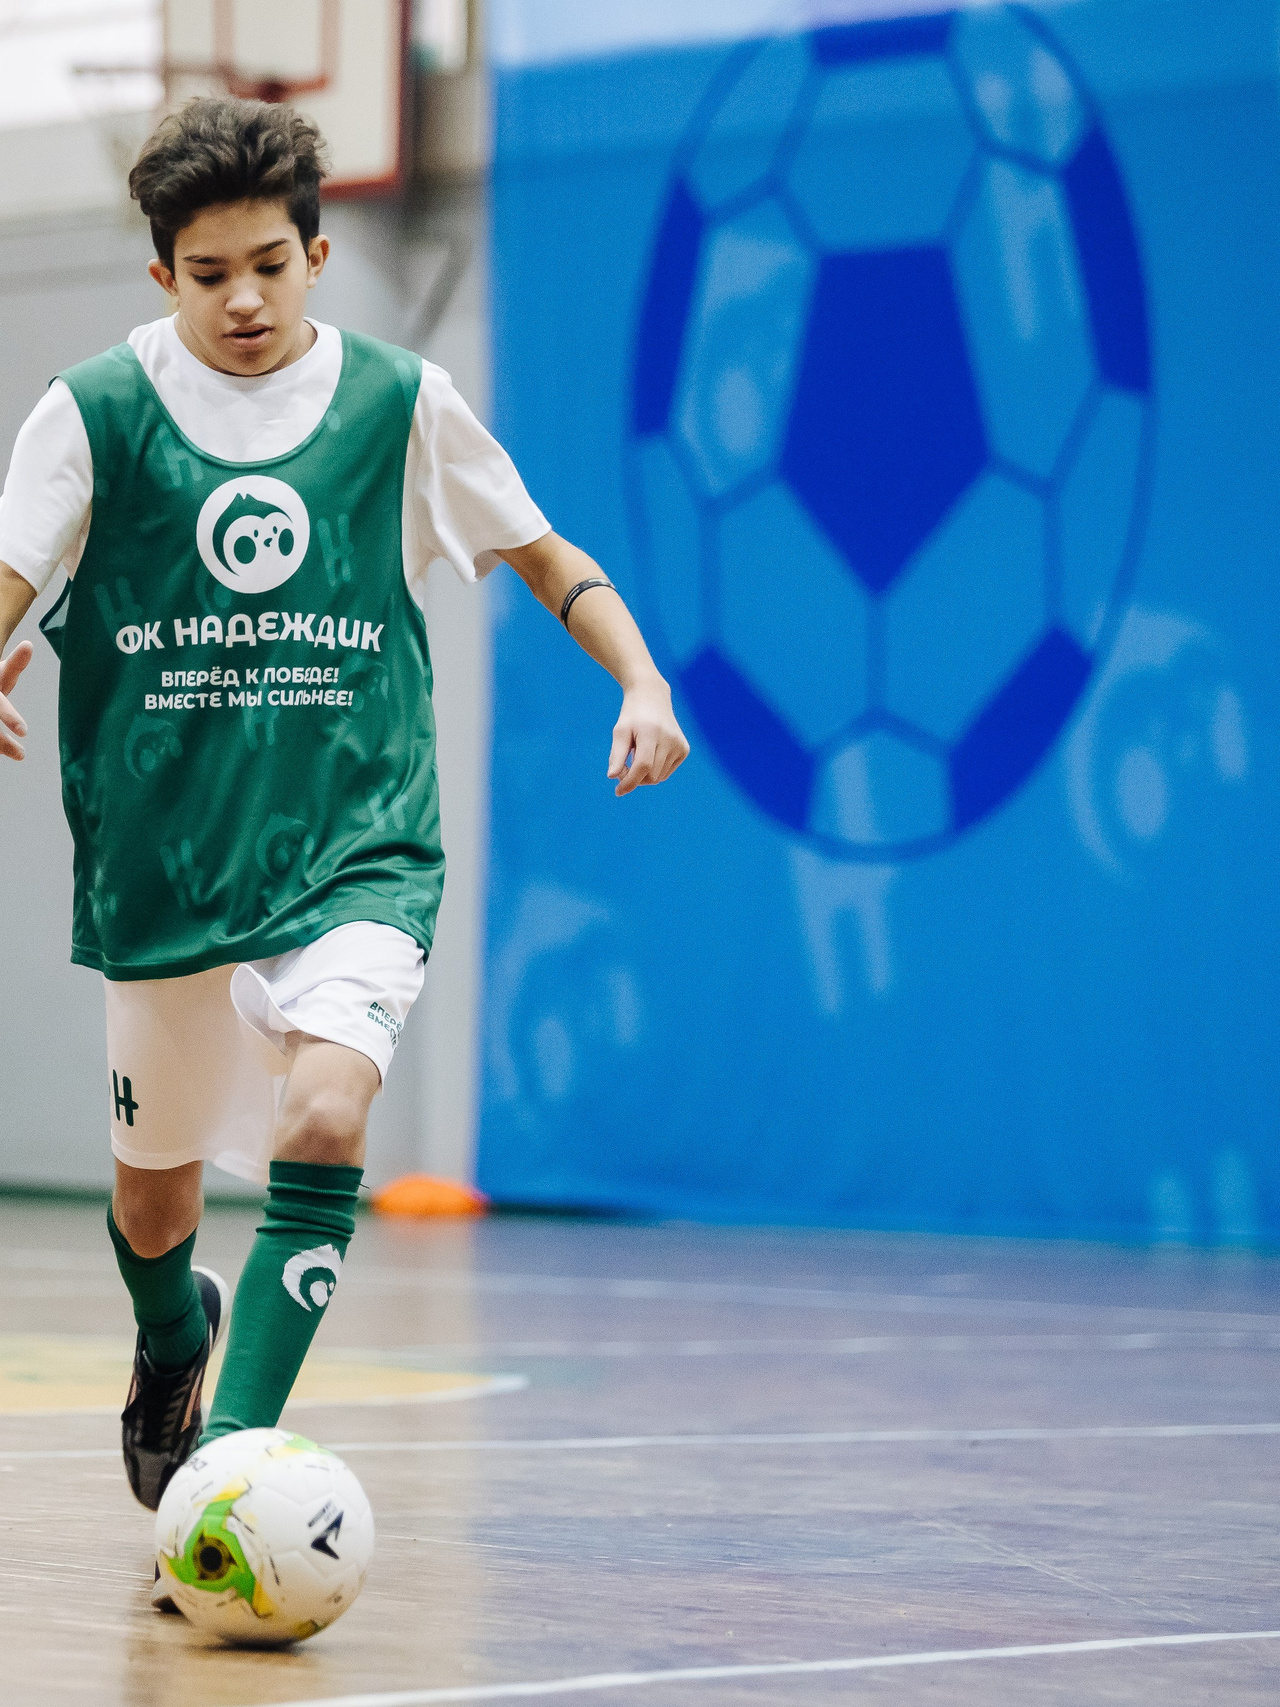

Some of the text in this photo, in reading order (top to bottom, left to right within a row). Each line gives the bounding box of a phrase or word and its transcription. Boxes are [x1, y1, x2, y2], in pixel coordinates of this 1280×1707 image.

[115, 611, 385, 655] ФК НАДЕЖДИК
[161, 666, 340, 688] ВПЕРЁД К ПОБЕДЕ!
[144, 689, 354, 710] ВМЕСТЕ МЫ СИЛЬНЕЕ!
